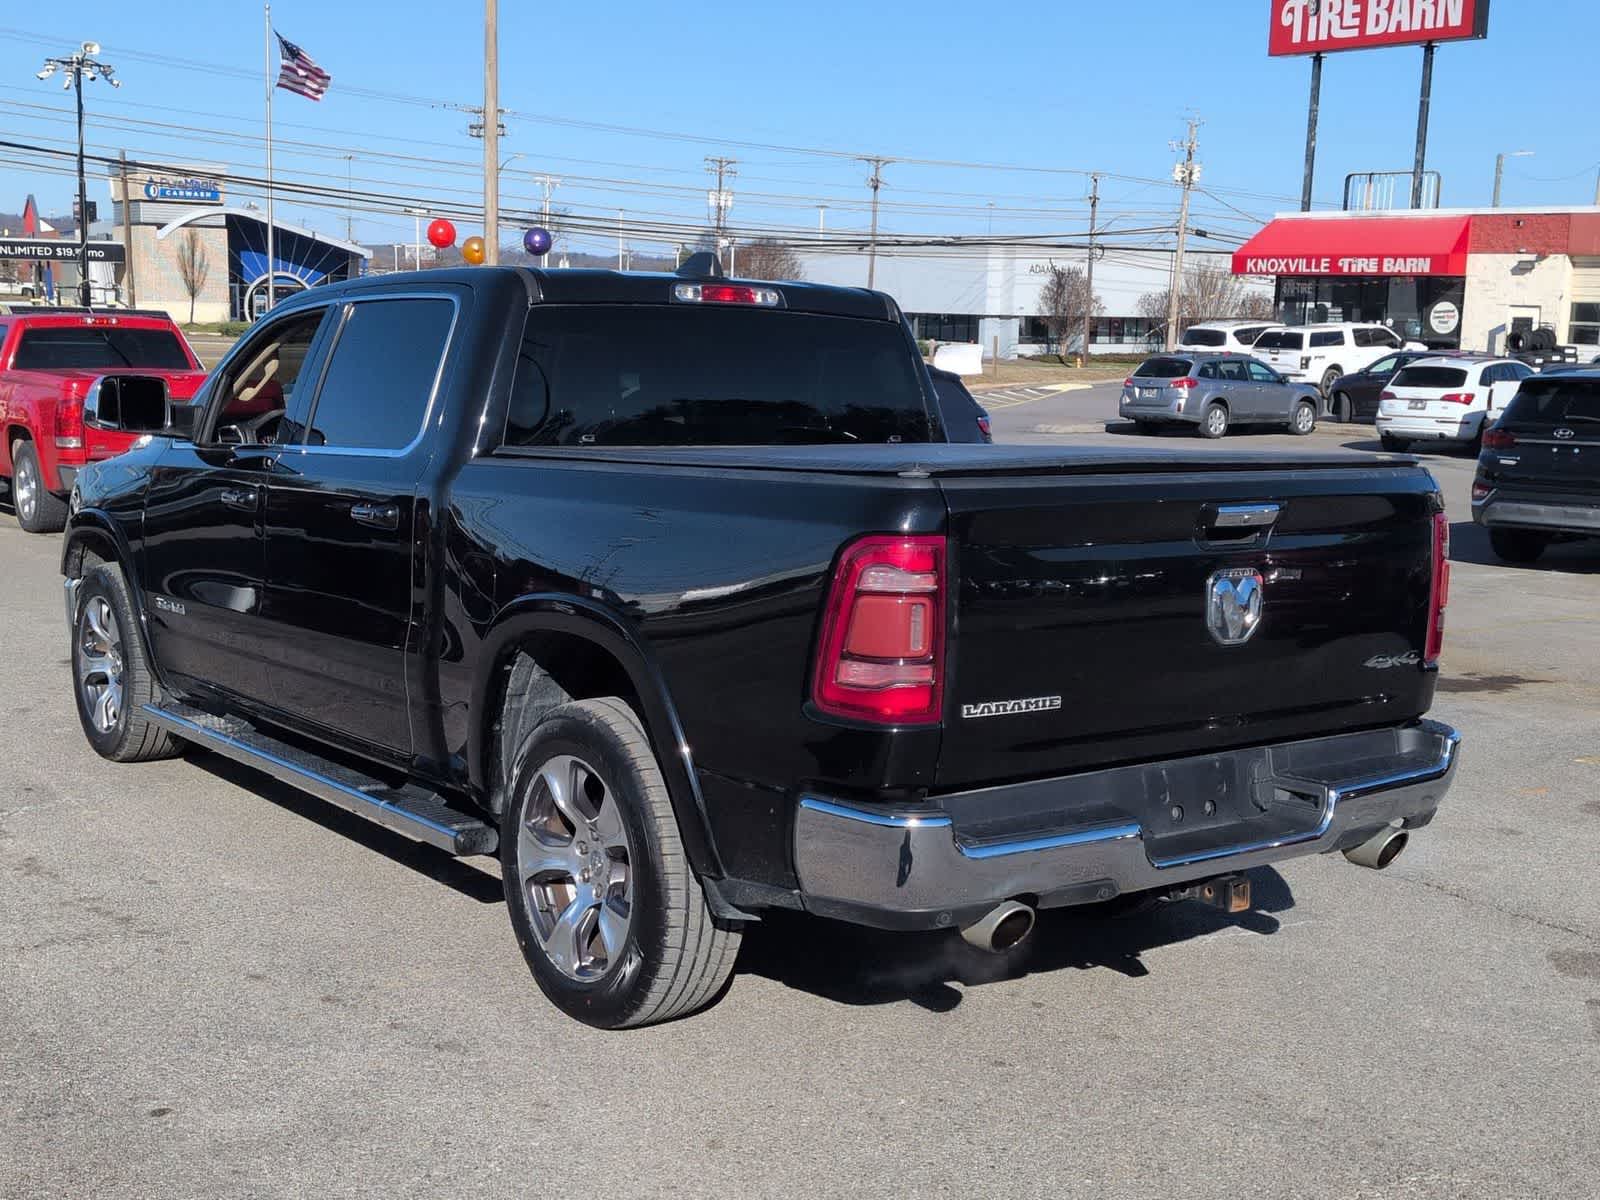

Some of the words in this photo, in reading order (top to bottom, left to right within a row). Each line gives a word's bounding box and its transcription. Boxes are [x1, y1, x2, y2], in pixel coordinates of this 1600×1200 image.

[1365, 0, 1463, 36] BARN
[1246, 258, 1330, 273] KNOXVILLE
[1382, 257, 1431, 273] BARN
[962, 695, 1062, 719] LARAMIE
